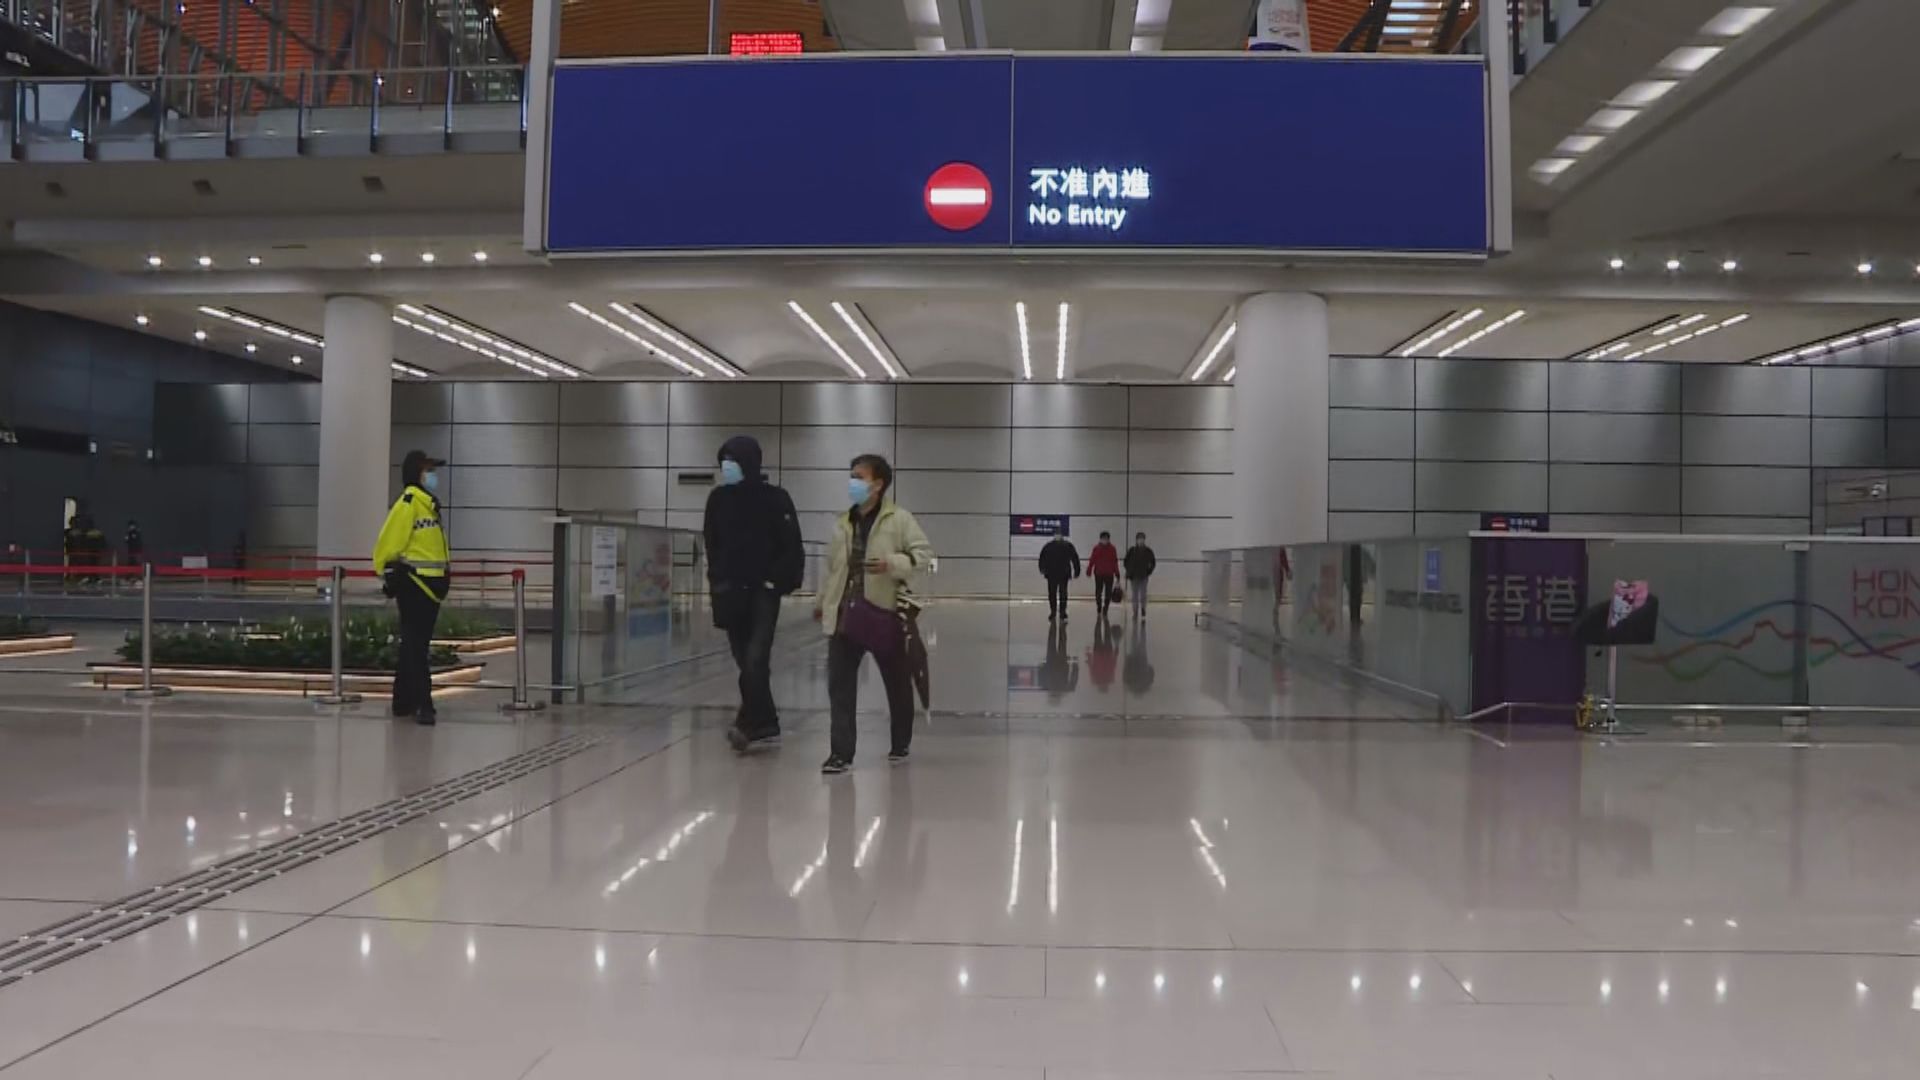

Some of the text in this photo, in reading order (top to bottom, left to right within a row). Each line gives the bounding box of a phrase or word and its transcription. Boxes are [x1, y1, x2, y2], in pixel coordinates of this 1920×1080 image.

[1030, 167, 1150, 199] 不准內進
[1029, 203, 1126, 231] No Entry
[1486, 575, 1577, 622] 香港
